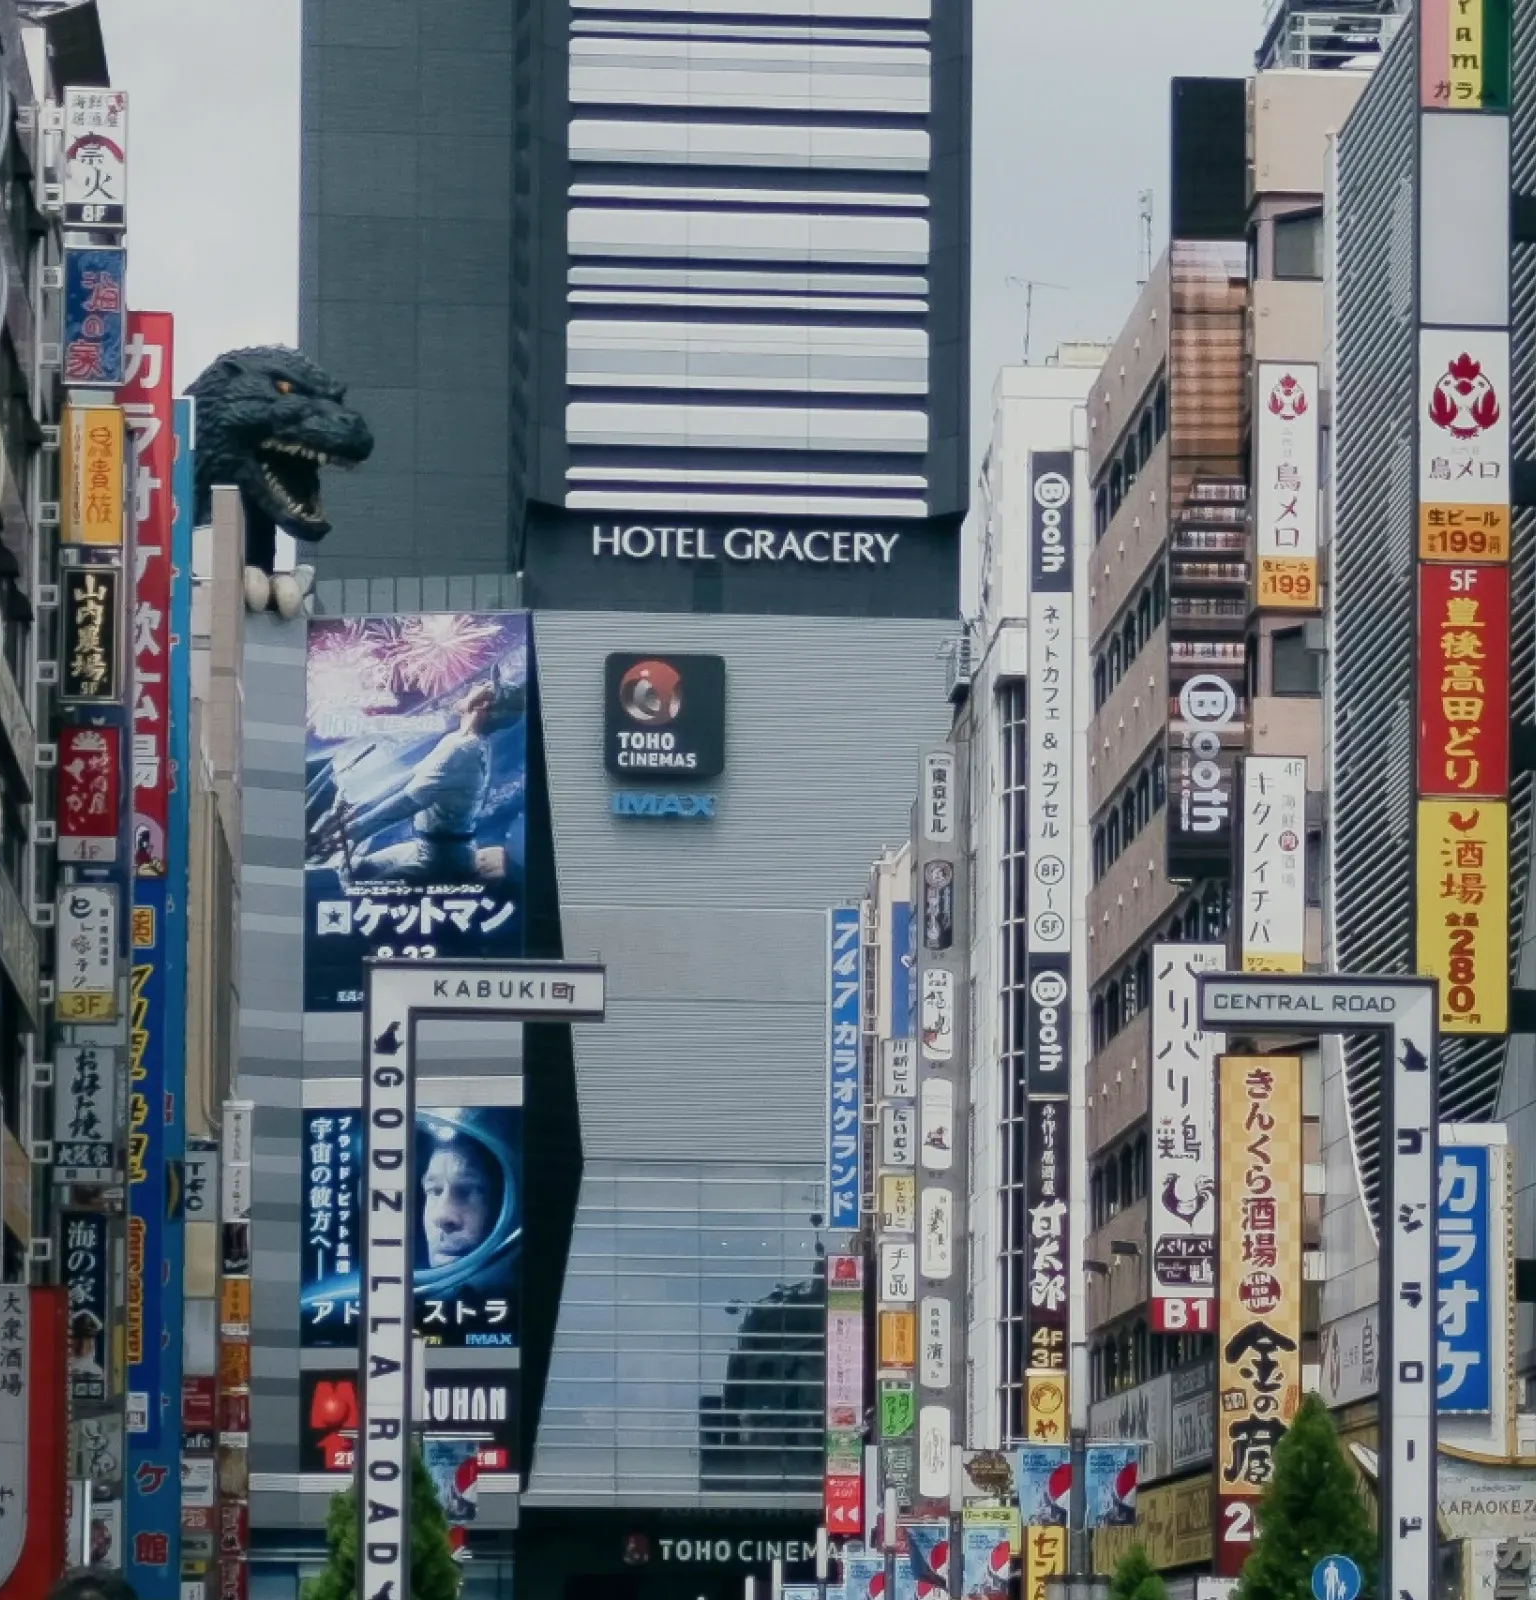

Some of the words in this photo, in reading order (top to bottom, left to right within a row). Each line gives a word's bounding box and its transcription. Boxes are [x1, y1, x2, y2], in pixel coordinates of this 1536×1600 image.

[1429, 457, 1501, 481] 鳥メロ
[1033, 472, 1070, 574] Booth
[1274, 461, 1302, 548] 鳥メロ
[1428, 507, 1500, 526] 生ビール
[592, 525, 716, 560] HOTEL
[724, 528, 900, 564] GRACERY
[1449, 569, 1478, 592] 5F
[1041, 604, 1060, 722] ネットカフェ
[1440, 597, 1487, 789] 豊後高田どり
[617, 731, 675, 751] TOHO
[617, 751, 697, 769] CINEMAS
[1041, 732, 1059, 750] &
[1179, 674, 1237, 833] Booth
[611, 791, 716, 818] IMAX
[1041, 760, 1060, 840] カプセル
[1440, 837, 1488, 906] 酒場
[1448, 929, 1478, 1013] 280
[72, 994, 102, 1016] 3F
[1030, 970, 1068, 1073] Booth
[1212, 992, 1324, 1011] CENTRAL
[1332, 994, 1397, 1013] ROAD
[831, 1020, 859, 1217] カラオケランド
[1241, 1067, 1277, 1269] きんくら酒場
[371, 1066, 405, 1380] GODZILLA
[1436, 1153, 1481, 1400] カラオケ
[1031, 1326, 1064, 1346] 4F
[1162, 1299, 1210, 1329] B1
[1031, 1349, 1064, 1368] 3F
[368, 1417, 401, 1566] ROAD
[658, 1536, 732, 1562] TOHO
